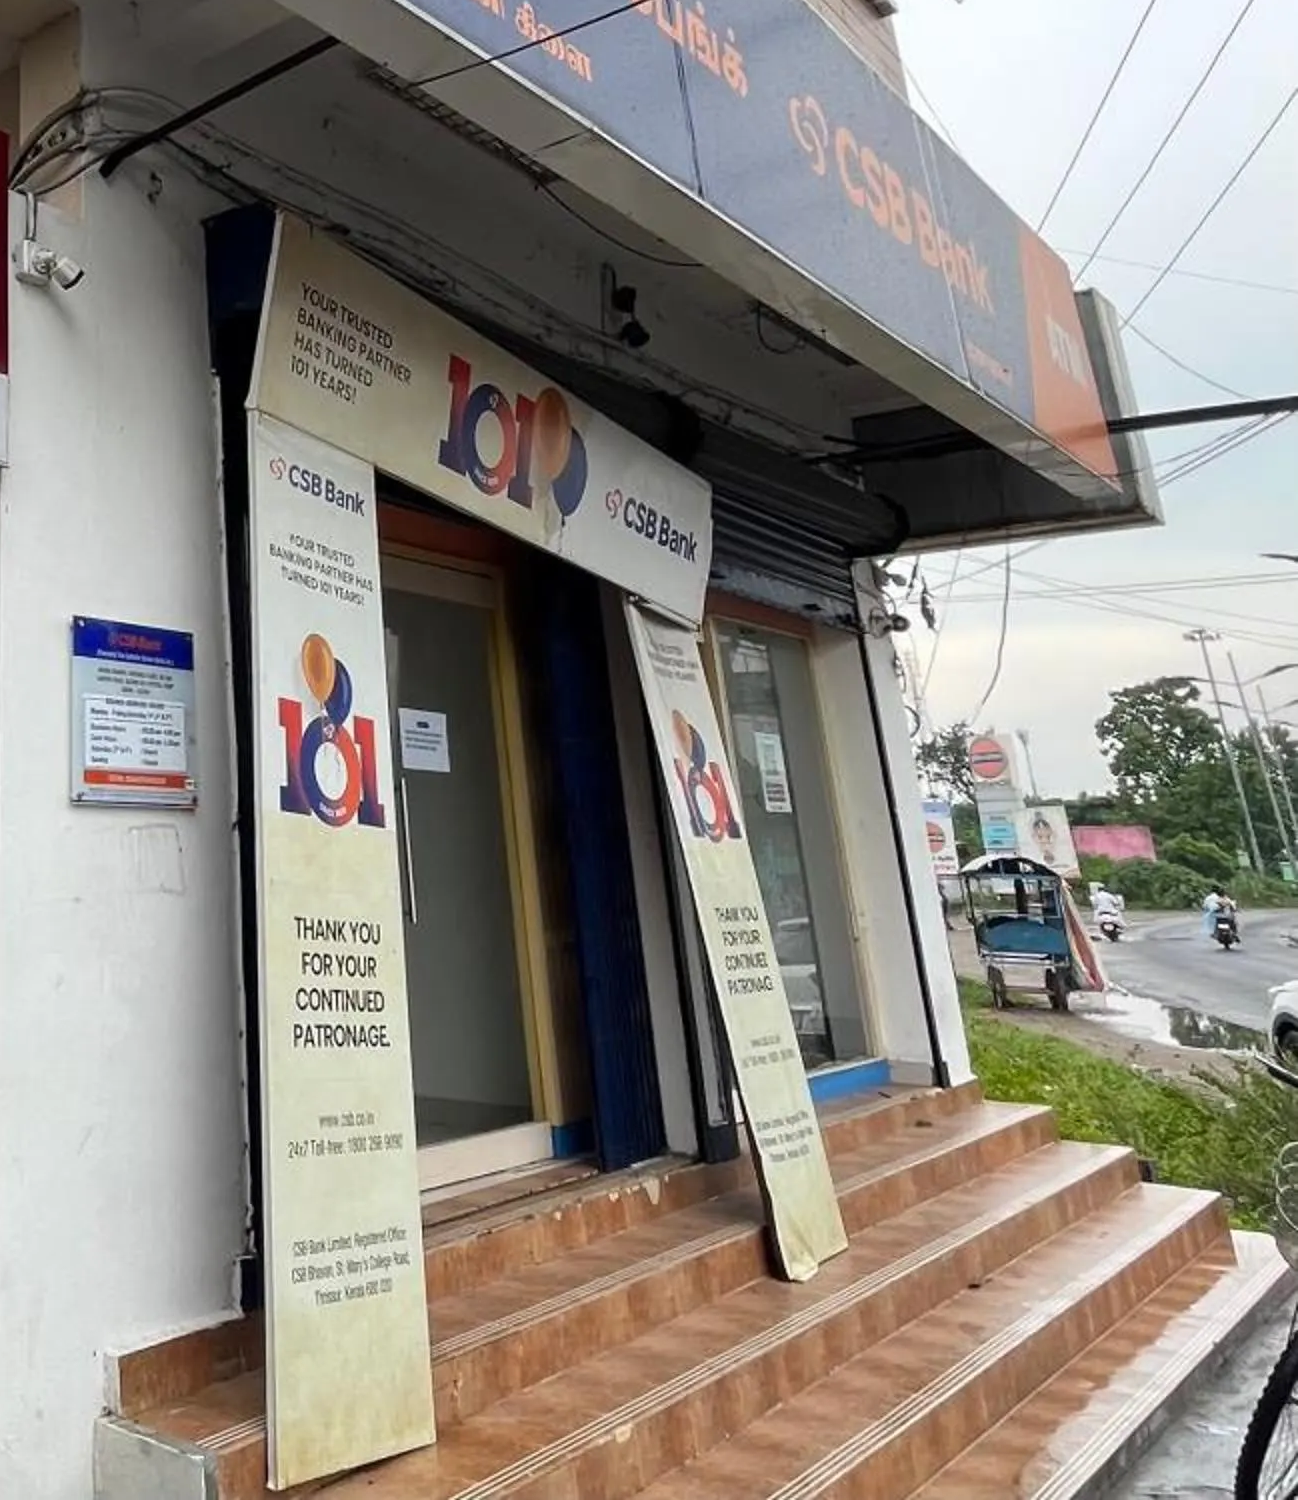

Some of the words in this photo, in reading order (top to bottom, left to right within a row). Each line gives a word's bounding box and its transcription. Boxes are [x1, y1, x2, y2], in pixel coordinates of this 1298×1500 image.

[835, 127, 912, 245] CSB
[912, 188, 996, 319] Bank
[302, 282, 338, 318] YOUR
[340, 305, 393, 349] TRUSTED
[294, 331, 321, 359] HAS
[325, 347, 373, 387] TURNED
[297, 307, 356, 352] BANKING
[358, 341, 412, 386] PARTNER
[312, 362, 357, 405] YEARS!
[289, 464, 322, 496] CSB
[324, 480, 364, 516] Bank
[623, 497, 656, 538] CSB
[657, 515, 698, 563] Bank
[277, 697, 386, 828] 101
[294, 916, 347, 942] THANK
[349, 921, 381, 945] YOU
[302, 952, 333, 977] FOR
[335, 954, 377, 978] YOUR
[295, 987, 385, 1012] CONTINUED
